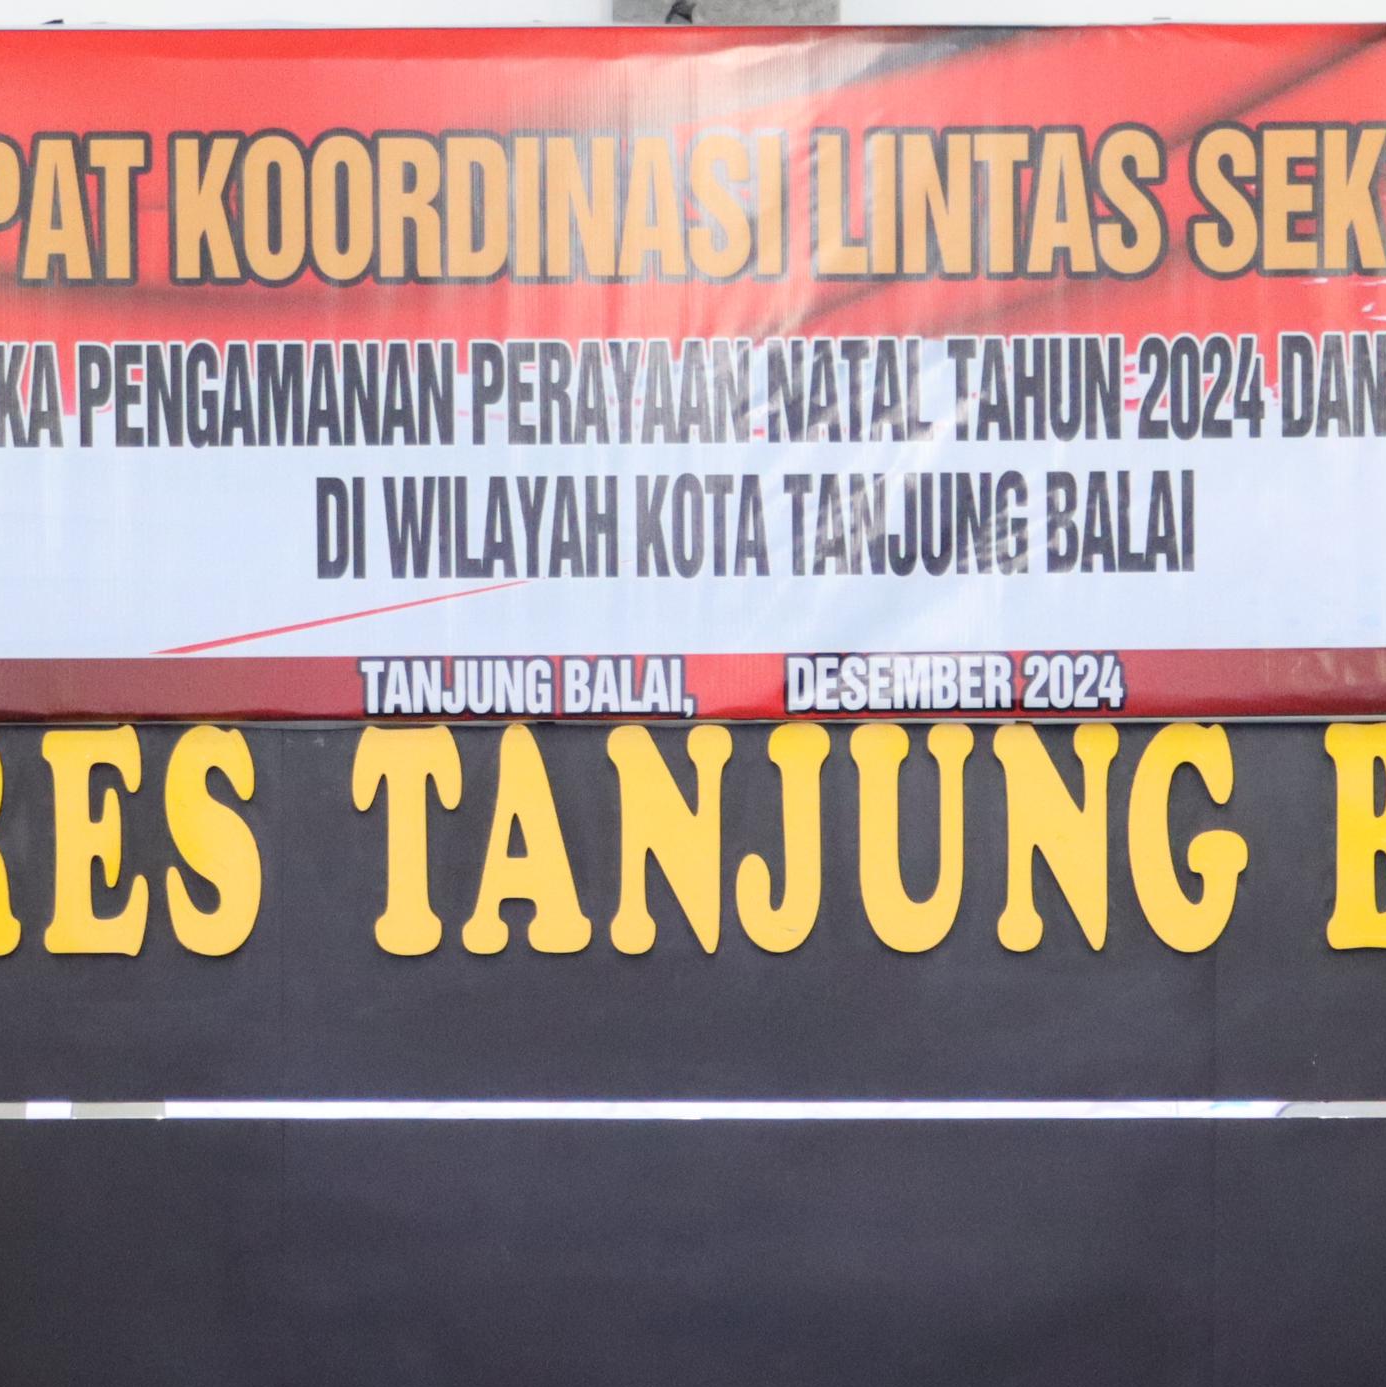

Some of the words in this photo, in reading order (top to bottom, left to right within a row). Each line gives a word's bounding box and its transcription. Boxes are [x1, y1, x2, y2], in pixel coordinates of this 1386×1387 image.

[170, 129, 787, 285] KOORDINASI
[813, 123, 1166, 281] LINTAS
[78, 340, 457, 447] PENGAMANAN
[470, 340, 750, 446] PERAYAAN
[767, 336, 934, 443] NATAL
[946, 334, 1121, 441] TAHUN
[1137, 334, 1266, 441] 2024
[315, 475, 366, 580] DI
[382, 474, 620, 579] WILAYAH
[635, 472, 771, 578] KOTA
[783, 470, 1029, 578] TANJUNG
[1045, 468, 1195, 573] BALAI
[360, 659, 552, 714] TANJUNG
[562, 658, 696, 717] BALAI,
[786, 653, 1012, 712] DESEMBER
[1023, 652, 1125, 708] 2024
[352, 723, 1249, 954] TANJUNG
